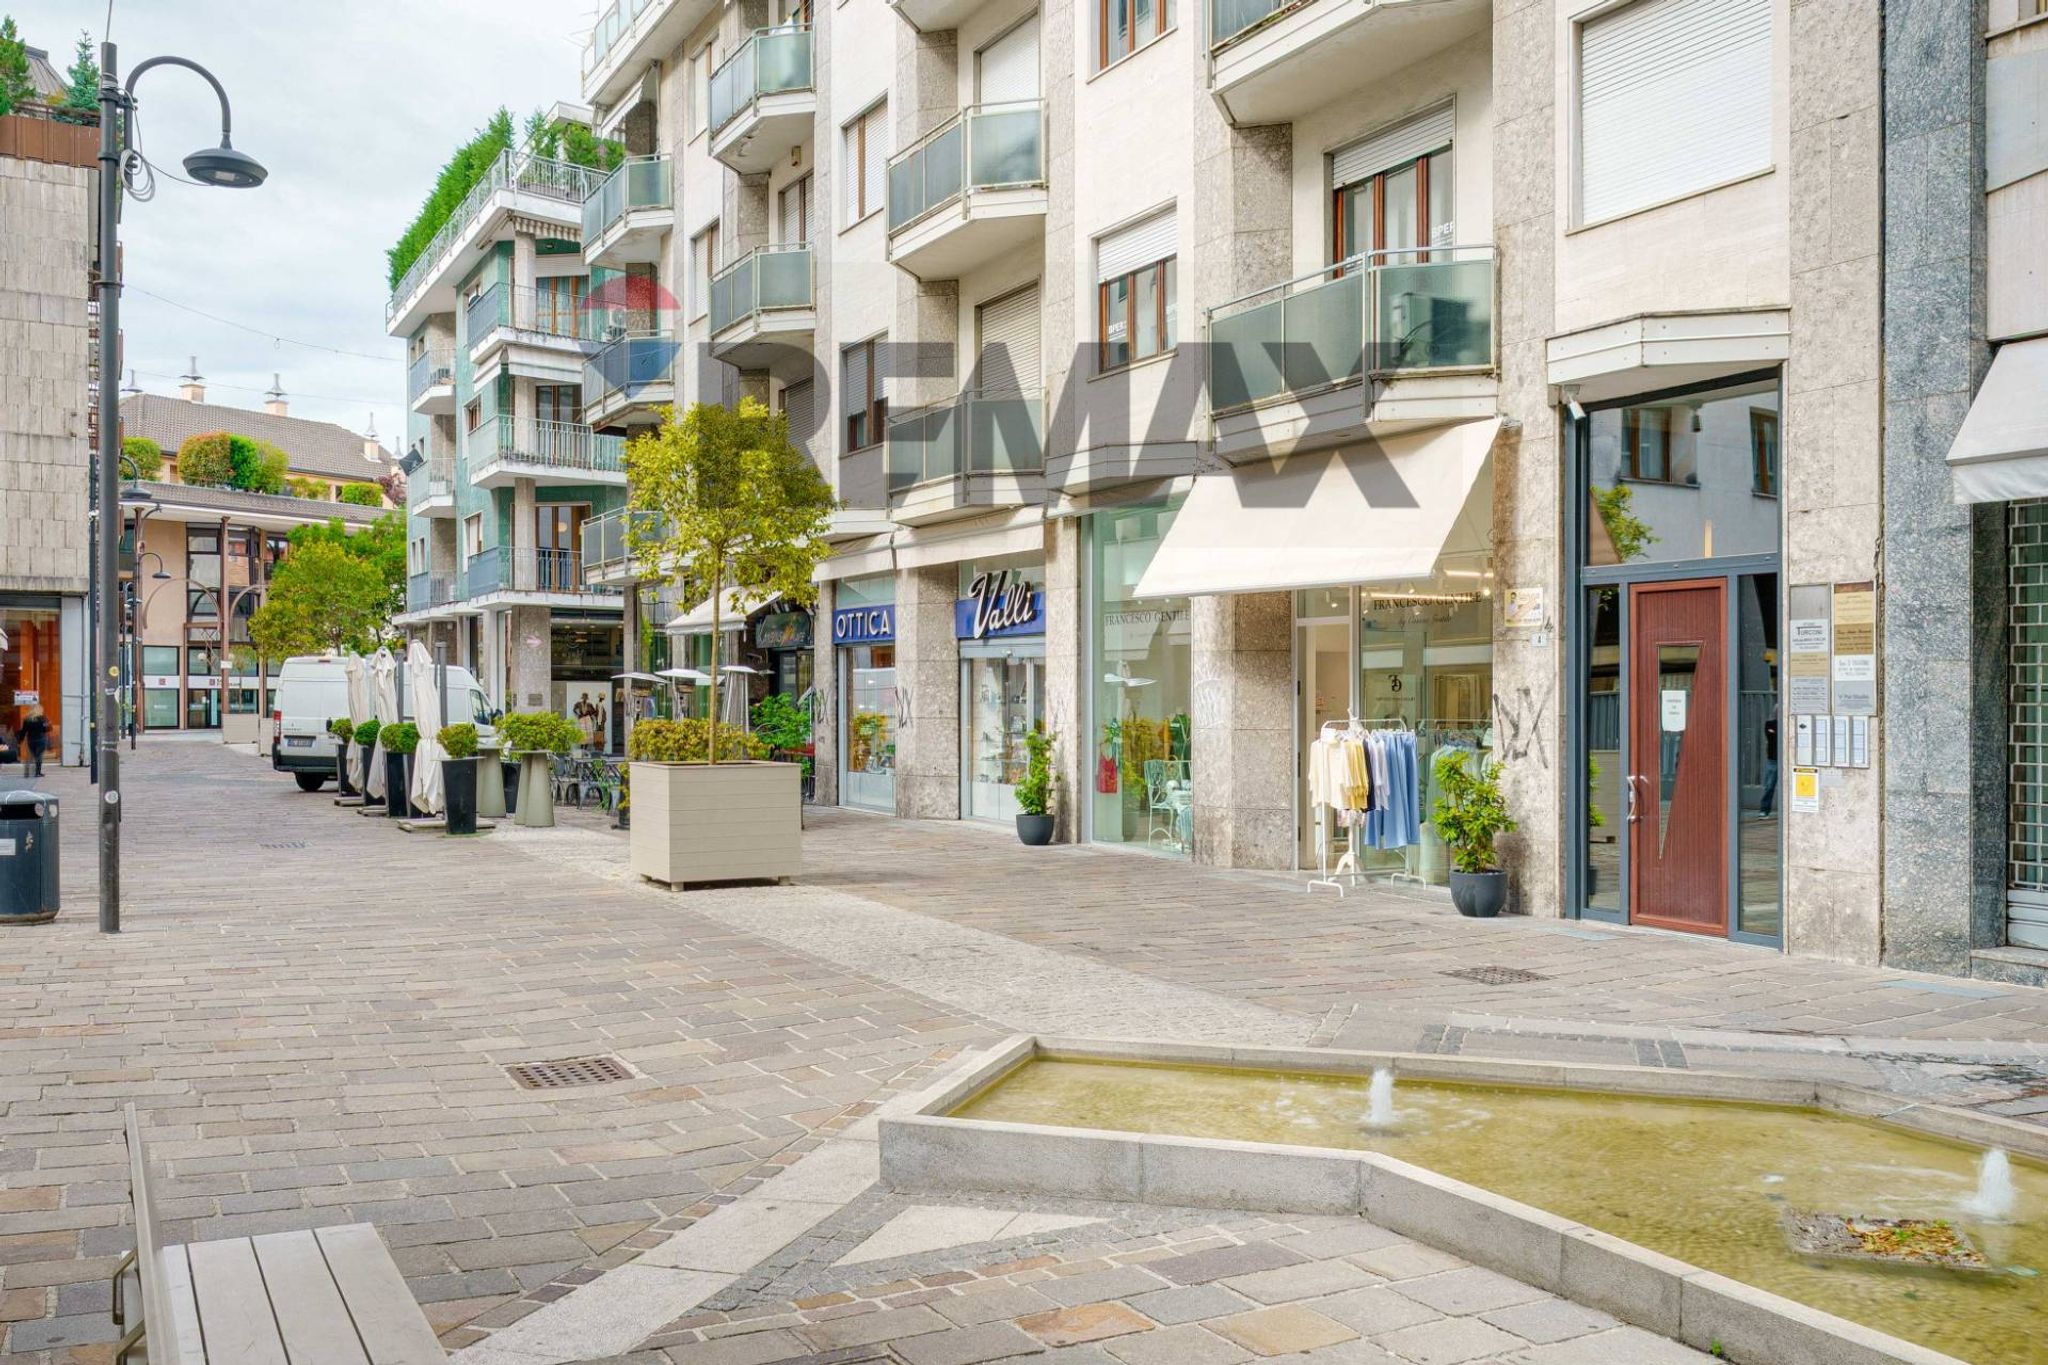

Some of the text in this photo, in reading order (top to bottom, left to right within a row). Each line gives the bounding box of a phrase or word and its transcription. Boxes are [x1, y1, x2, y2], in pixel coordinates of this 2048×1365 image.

[968, 569, 1034, 639] Valli
[1374, 592, 1481, 610] FRANCESCO GENTILE
[836, 610, 891, 638] OTTICA
[1106, 608, 1191, 626] FRANCESCO GENTILE
